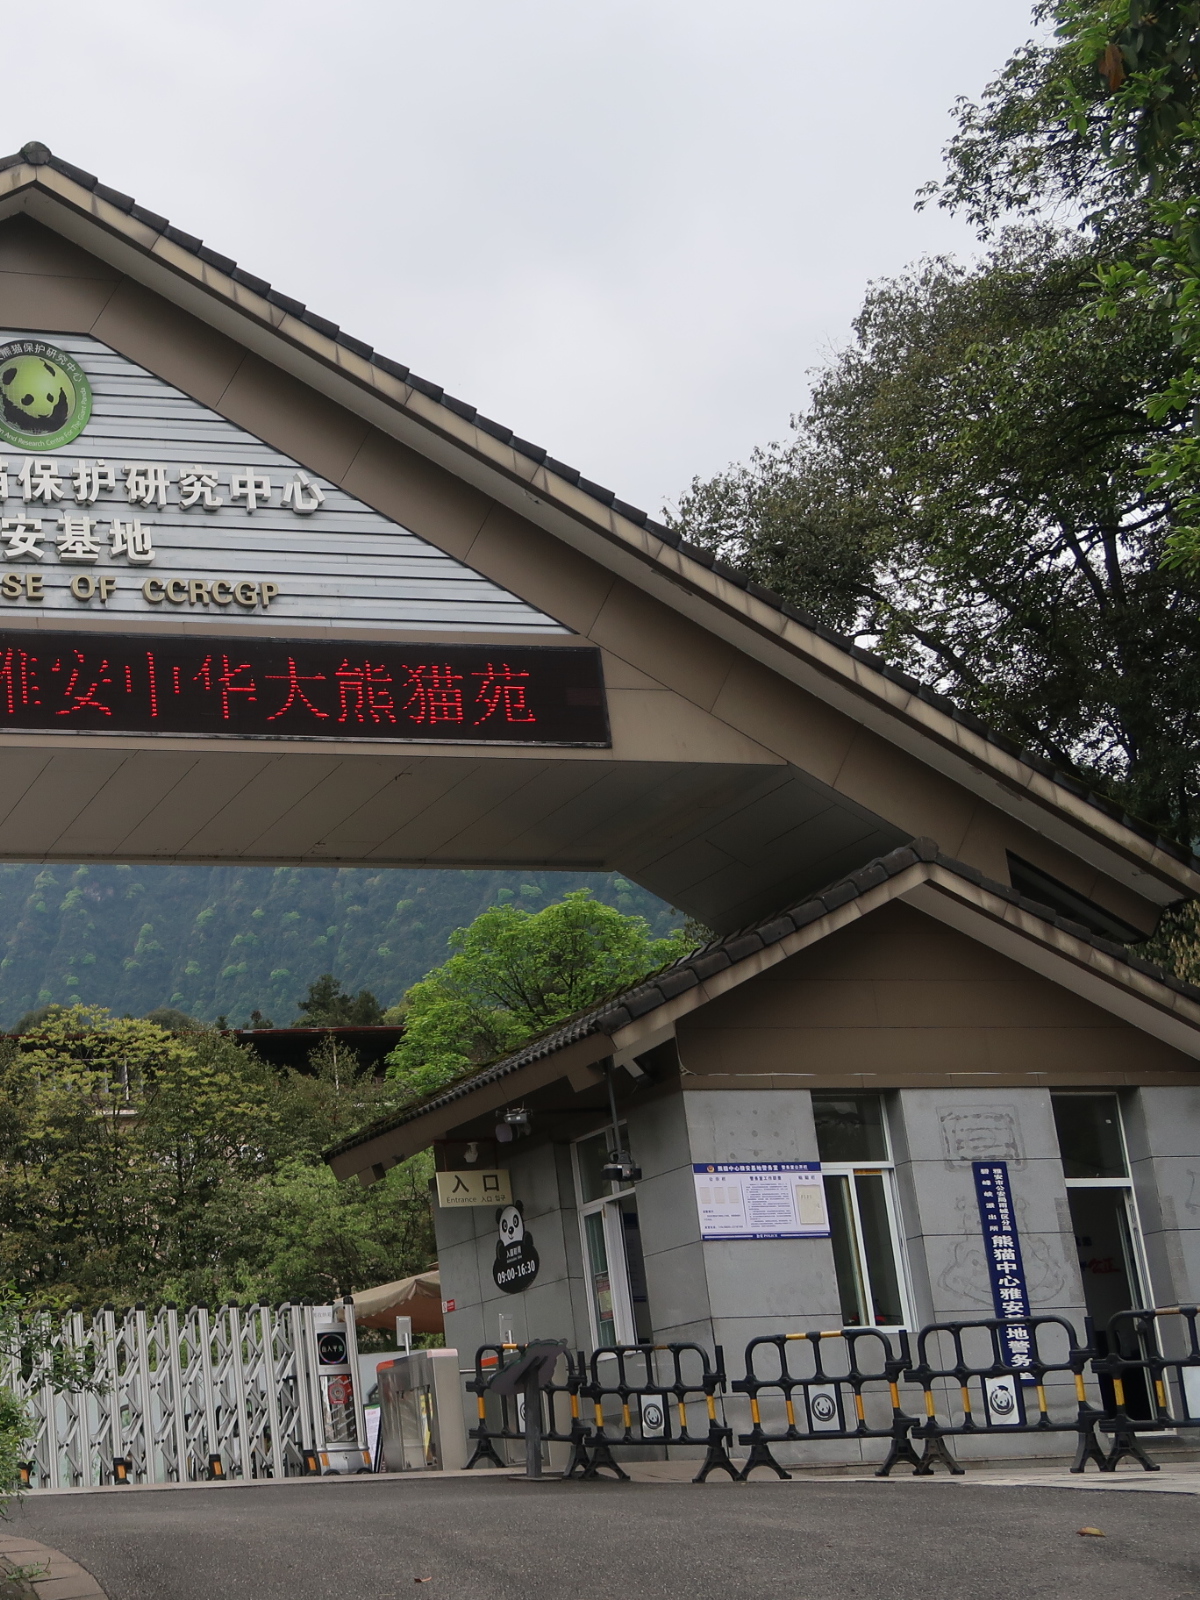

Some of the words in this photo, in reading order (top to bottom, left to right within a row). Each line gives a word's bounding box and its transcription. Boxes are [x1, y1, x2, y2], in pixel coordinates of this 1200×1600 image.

[4, 432, 18, 442] And
[18, 437, 46, 447] Research
[46, 436, 65, 446] Centre
[63, 429, 74, 438] For
[71, 420, 82, 430] The
[80, 387, 88, 405] Panda
[71, 574, 118, 602] OF
[142, 577, 280, 608] CCRCGP
[452, 1174, 500, 1193] 入口
[446, 1195, 478, 1204] Entrance
[497, 1260, 536, 1284] 09:00-16:30
